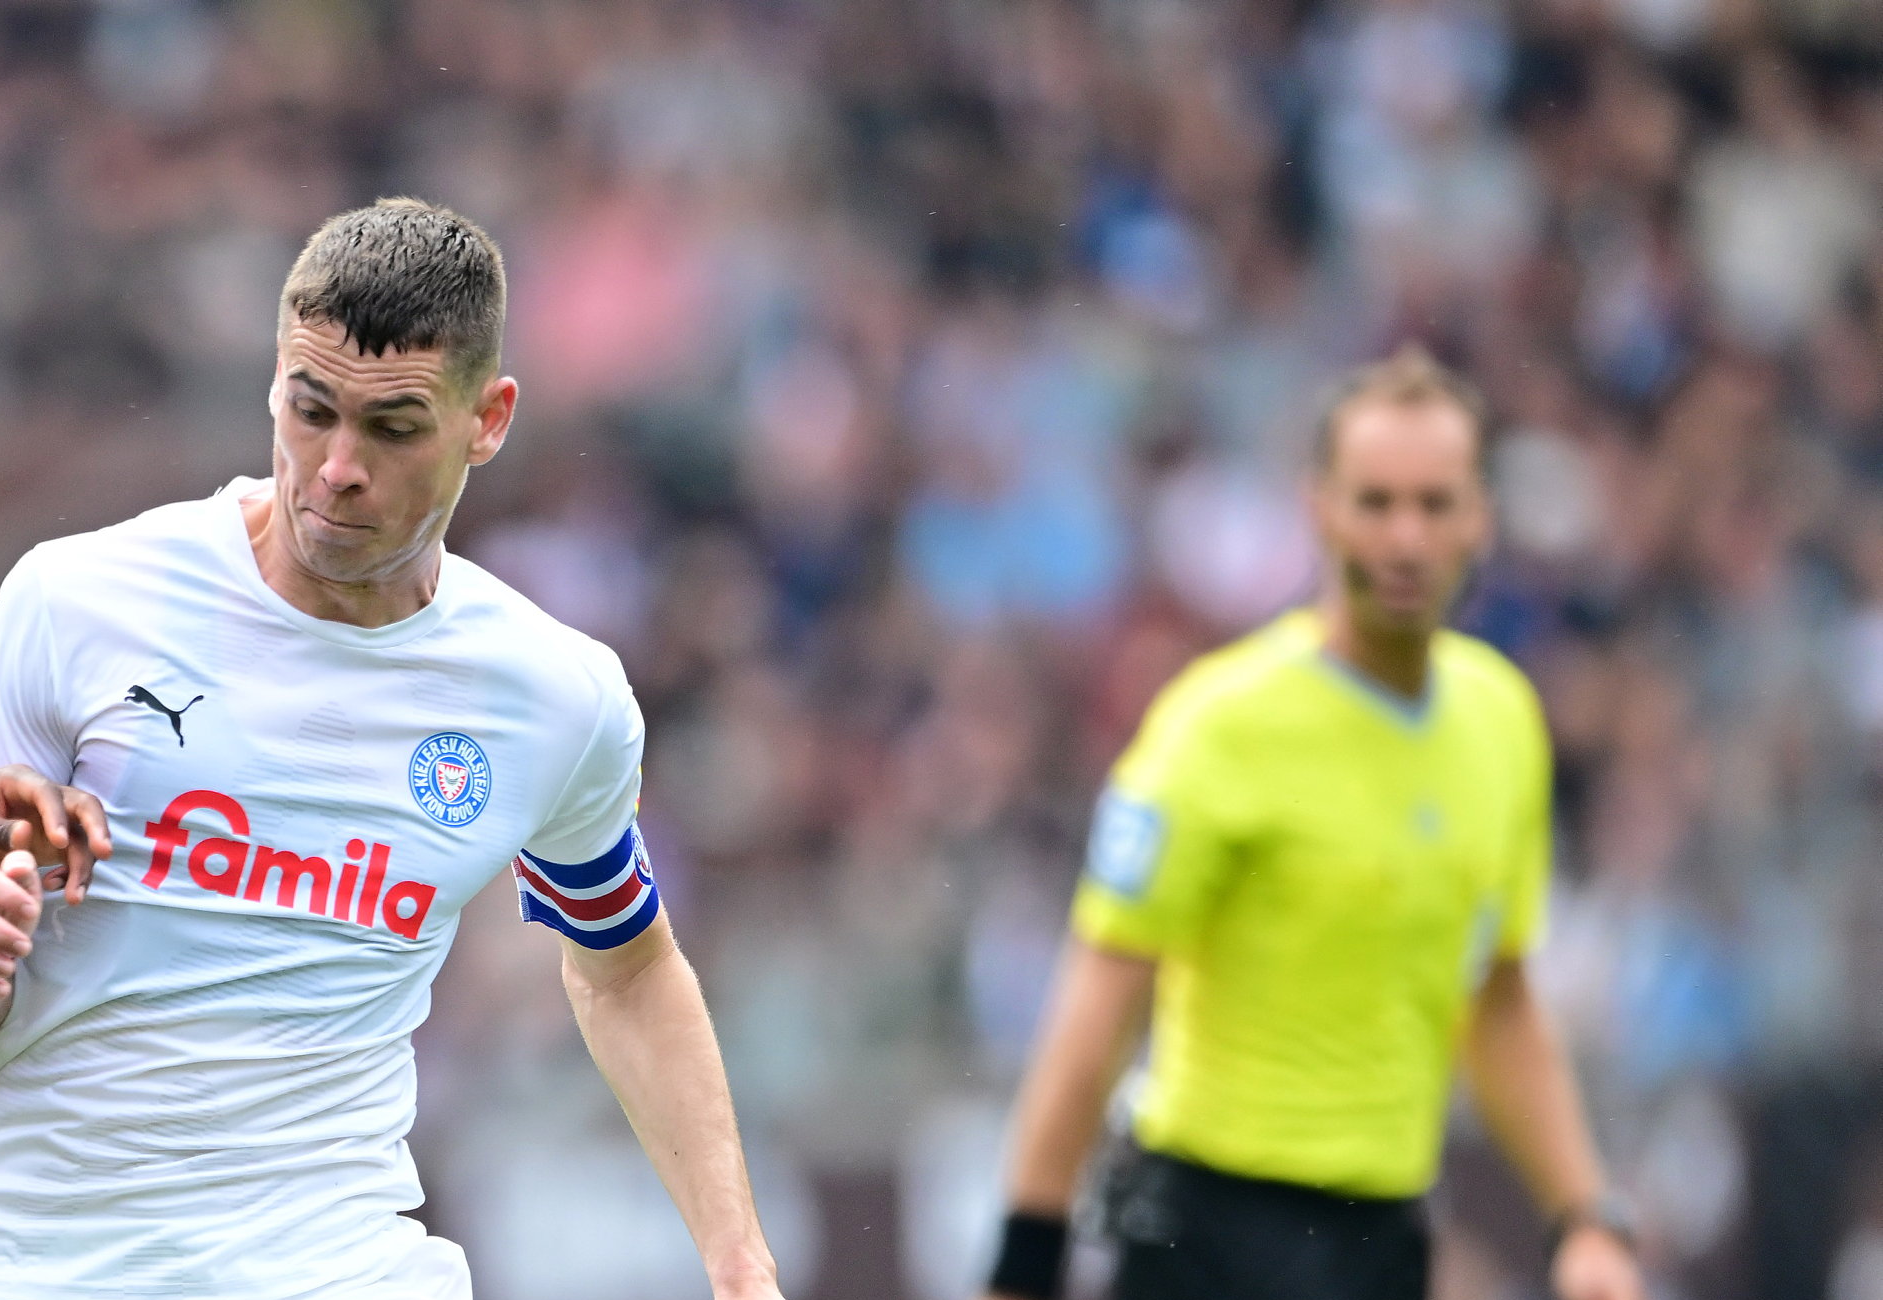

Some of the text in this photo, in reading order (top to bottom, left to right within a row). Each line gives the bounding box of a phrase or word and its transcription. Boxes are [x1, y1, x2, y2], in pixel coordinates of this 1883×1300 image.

[413, 742, 442, 788] KIELER
[457, 740, 488, 803] HOLSTEIN
[421, 790, 475, 822] VON 1900
[140, 789, 438, 941] famila
